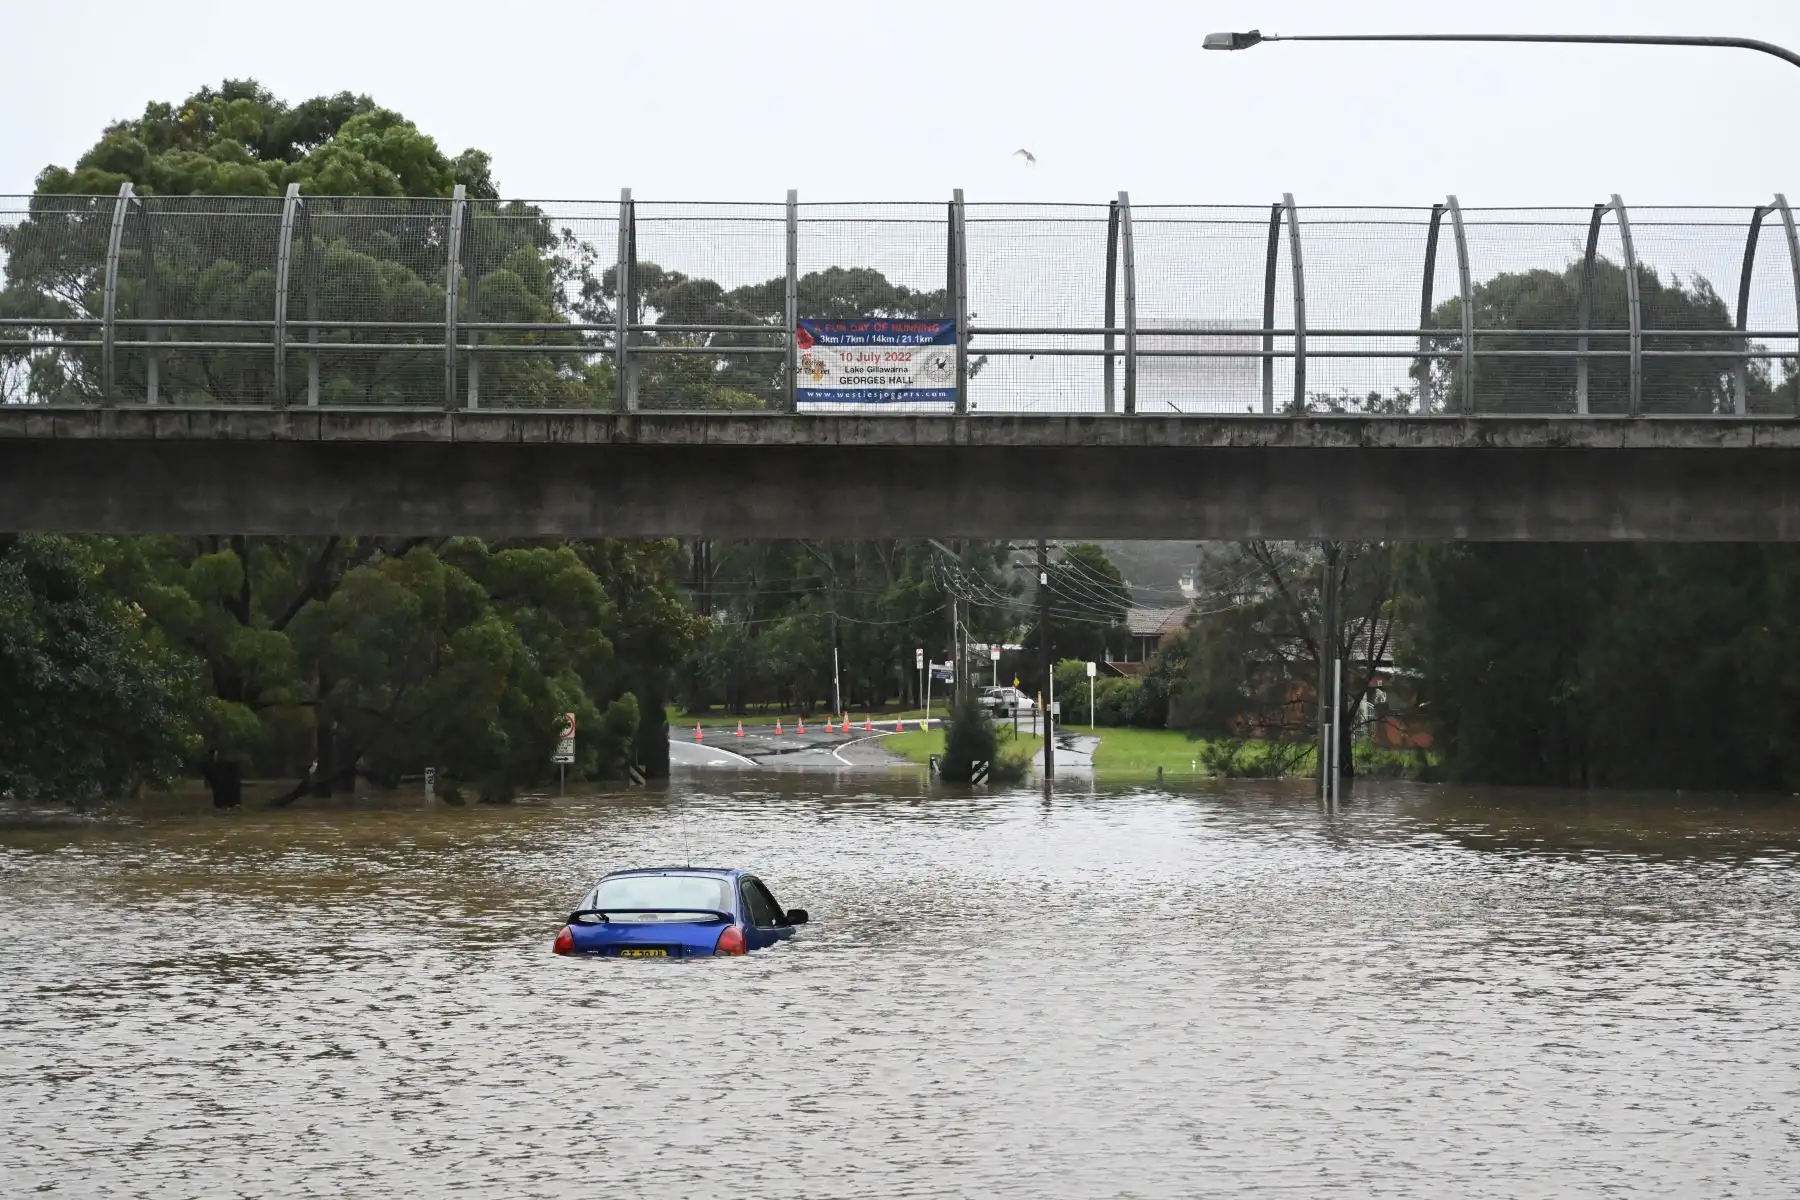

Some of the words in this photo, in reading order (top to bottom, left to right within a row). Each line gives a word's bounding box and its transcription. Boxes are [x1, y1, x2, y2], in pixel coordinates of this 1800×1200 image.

[824, 324, 846, 333] FUN
[850, 324, 870, 333] DAY
[872, 324, 888, 333] OF
[891, 324, 940, 333] RUNNING
[820, 334, 839, 344] 3km
[845, 335, 865, 344] 7km
[872, 334, 895, 344] 14km
[902, 334, 934, 344] 21.1km
[840, 352, 853, 362] 10
[856, 352, 881, 364] July
[884, 352, 912, 362] 2022
[844, 366, 864, 374] Lake
[866, 366, 909, 374] Gillawarna
[839, 376, 885, 385] GEORGES
[888, 376, 914, 385] HALL
